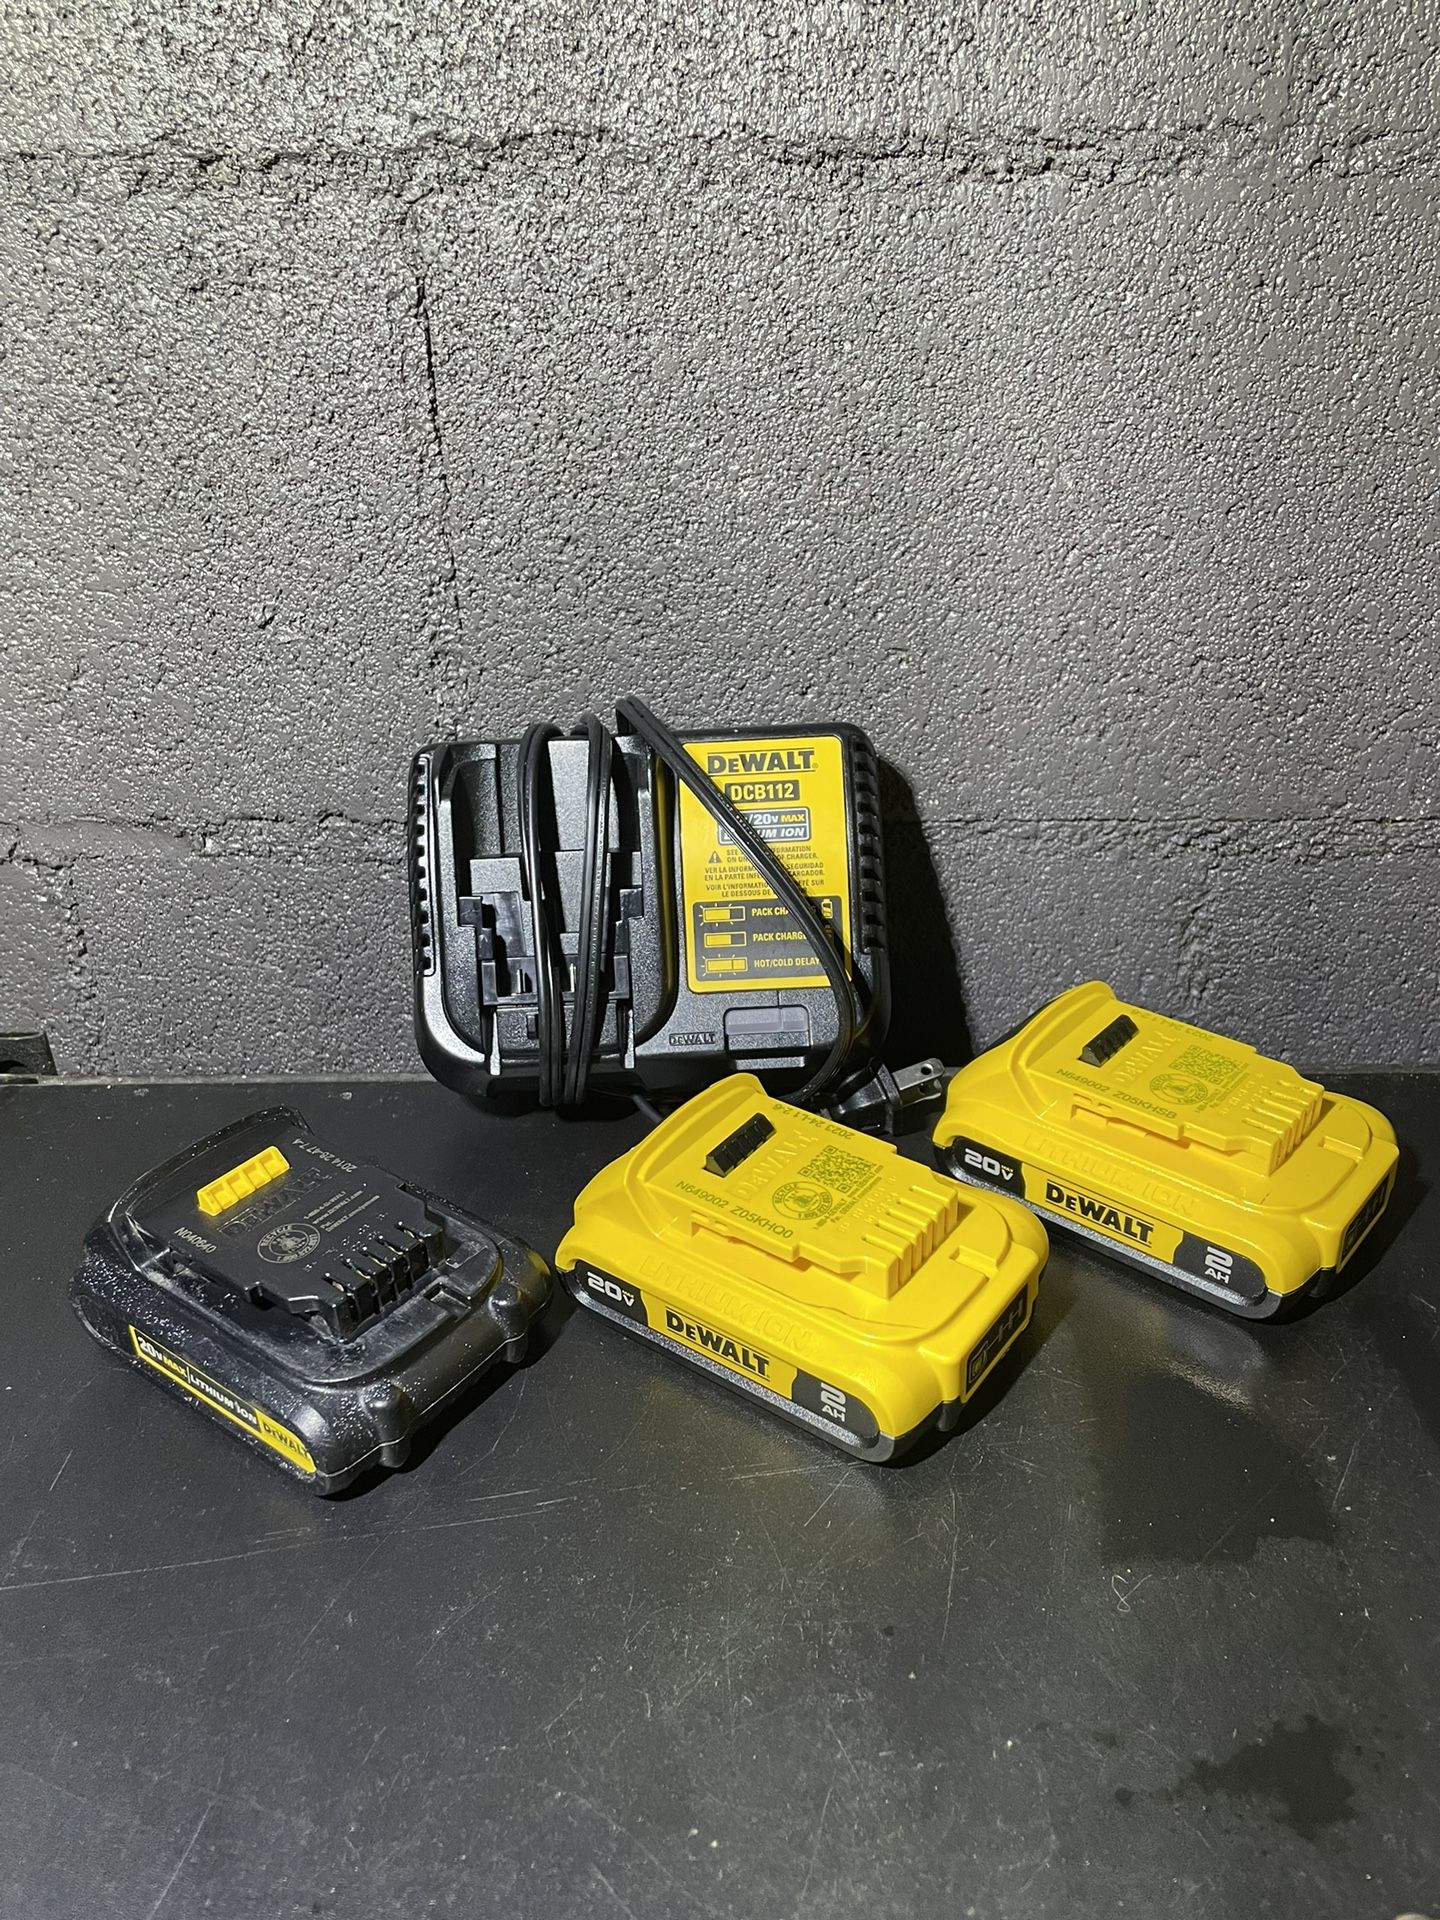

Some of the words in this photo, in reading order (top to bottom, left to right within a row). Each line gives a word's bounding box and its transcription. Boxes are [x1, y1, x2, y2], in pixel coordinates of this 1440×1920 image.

[707, 750, 815, 775] DEWALT
[731, 783, 794, 801] DCB112
[781, 814, 805, 823] MAX
[780, 827, 805, 837] ION
[751, 907, 773, 916] PACK
[752, 932, 774, 942] PACK
[754, 958, 793, 968] HOT/COLD
[825, 1125, 856, 1140] 2023
[332, 1157, 358, 1173] 2014
[678, 1180, 730, 1209] N649002
[1046, 1182, 1153, 1244] DEWALT
[1204, 1246, 1233, 1275] 2
[1204, 1269, 1230, 1284] AH
[665, 1309, 770, 1377] DEWALT
[190, 1374, 234, 1410] LITHIUM
[820, 1382, 847, 1413] 2
[821, 1404, 846, 1422] AH
